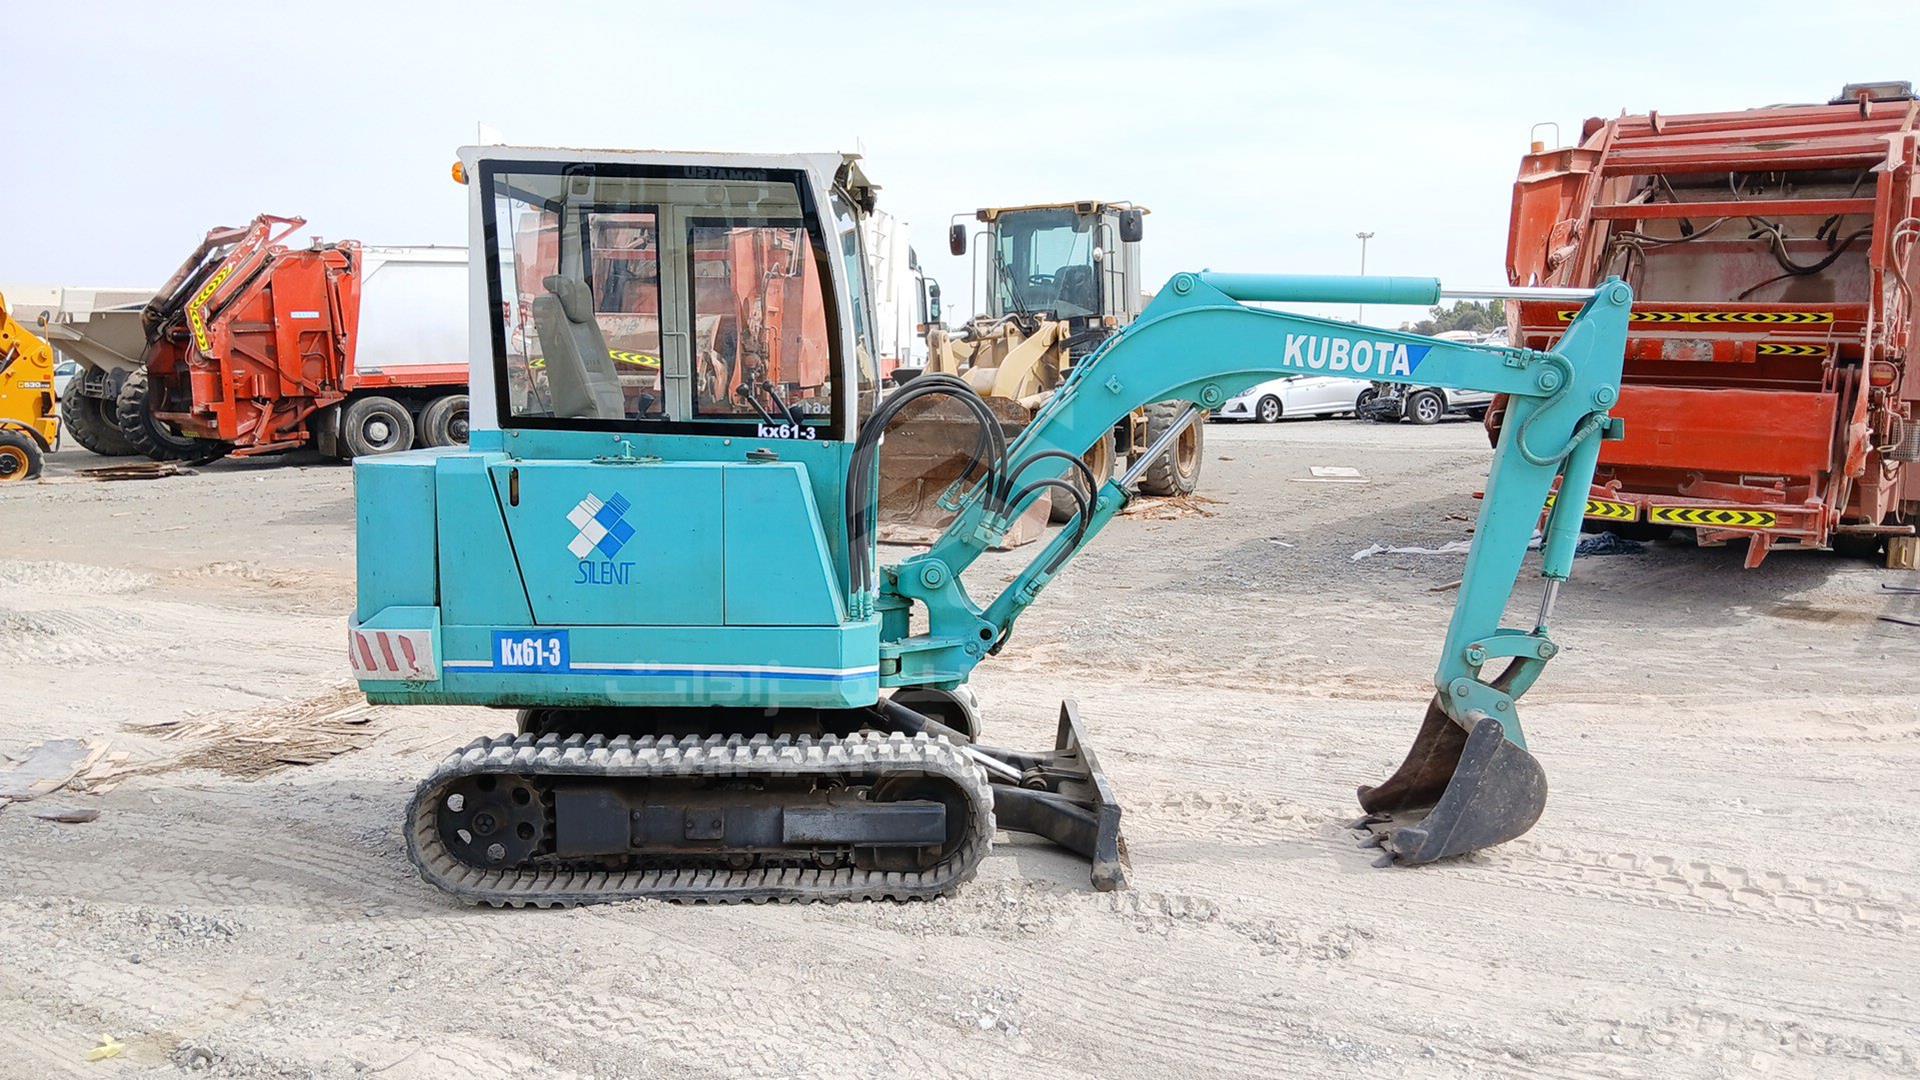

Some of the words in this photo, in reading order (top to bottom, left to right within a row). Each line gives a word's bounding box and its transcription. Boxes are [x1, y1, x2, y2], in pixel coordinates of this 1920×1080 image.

[1283, 334, 1411, 376] KUBOTA
[757, 423, 816, 440] kx61-3
[574, 560, 636, 584] SILENT
[501, 637, 561, 666] Kx61-3
